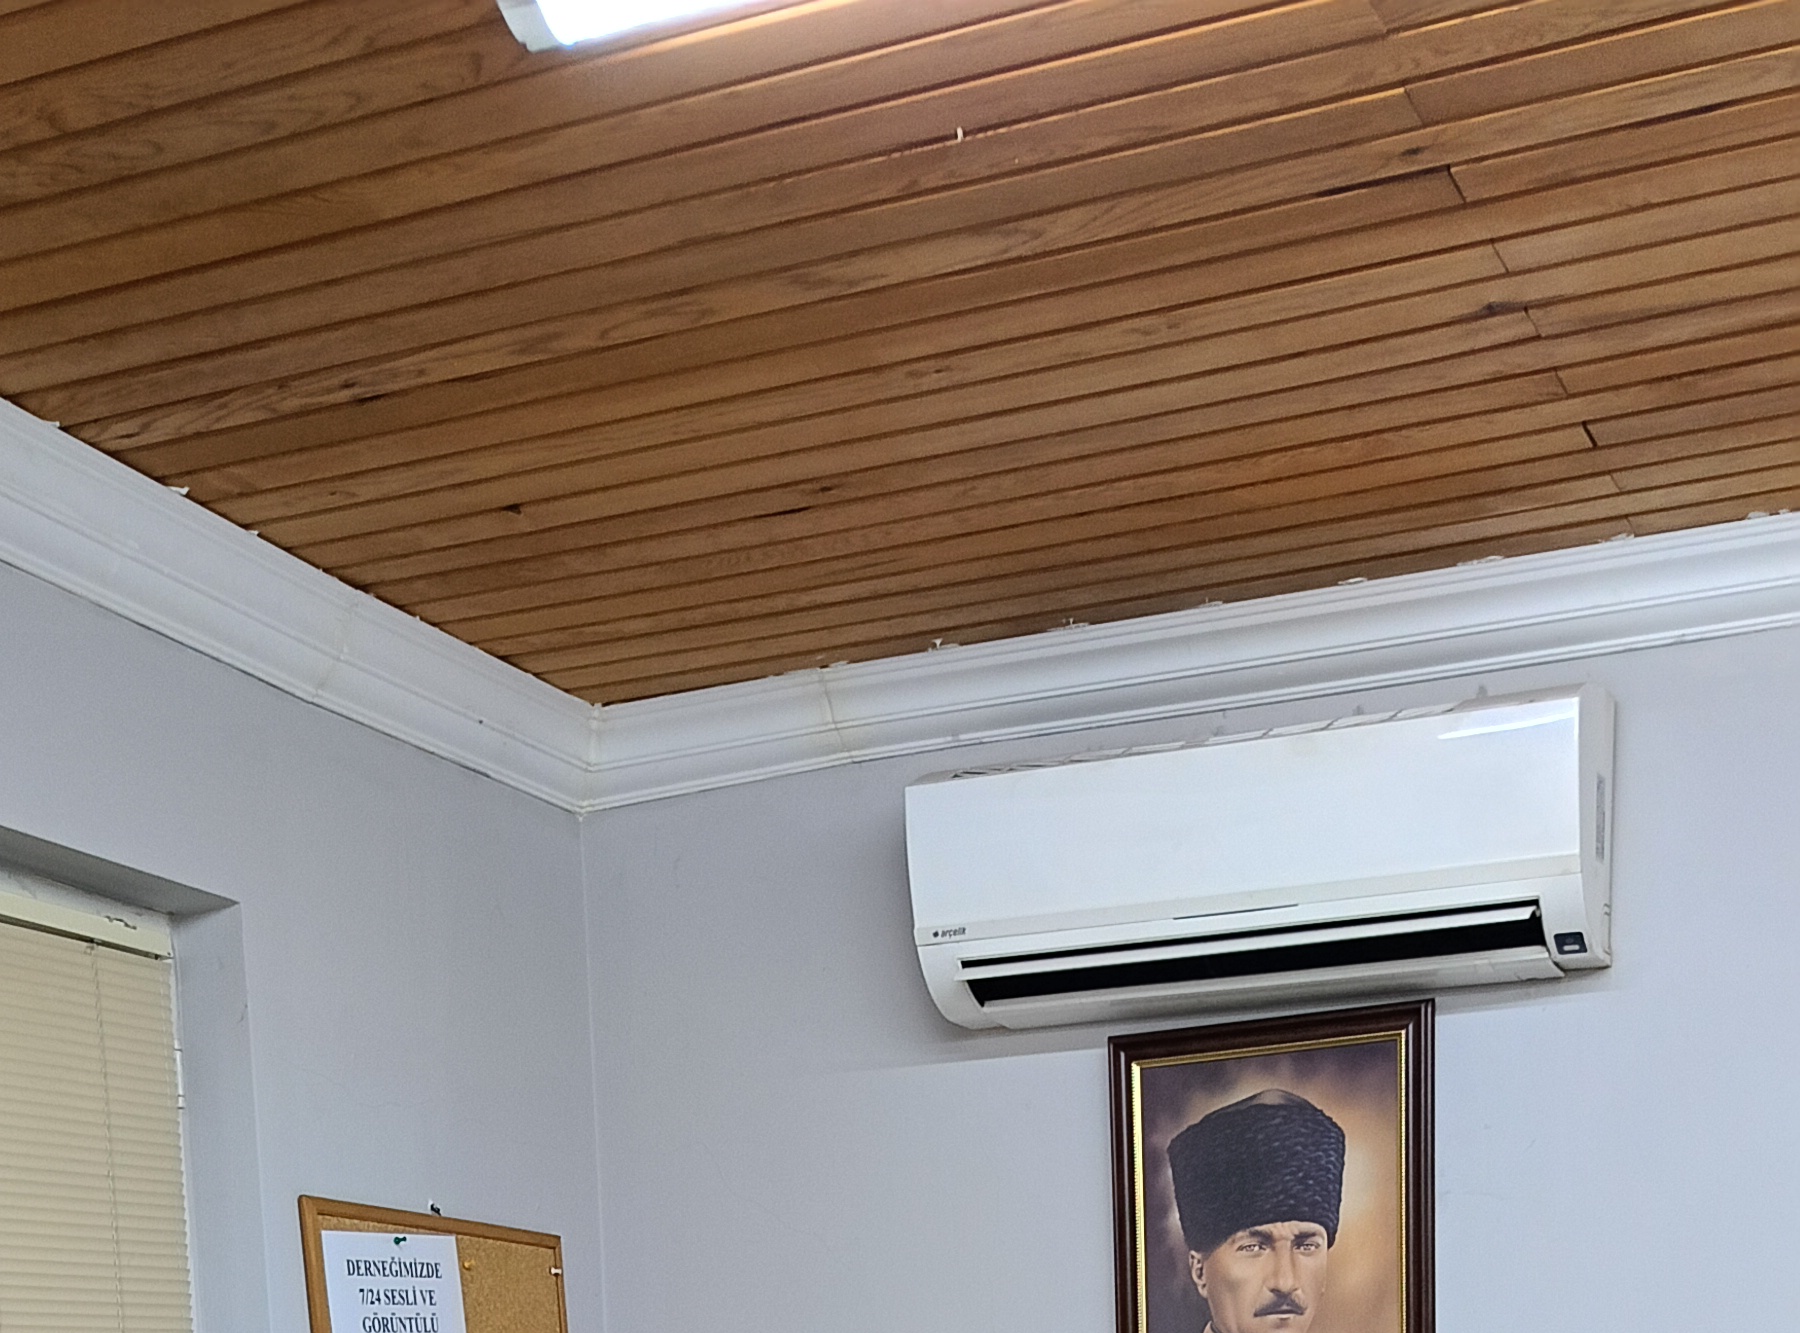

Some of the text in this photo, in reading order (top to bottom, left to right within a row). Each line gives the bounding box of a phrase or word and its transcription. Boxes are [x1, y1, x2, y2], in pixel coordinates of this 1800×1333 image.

[941, 927, 966, 939] arçelik
[346, 1256, 442, 1279] DERNEĞİMİZDE
[358, 1286, 437, 1306] 7/24 SESLİ VE
[362, 1312, 439, 1333] GÖRÜNTÜLÜ
